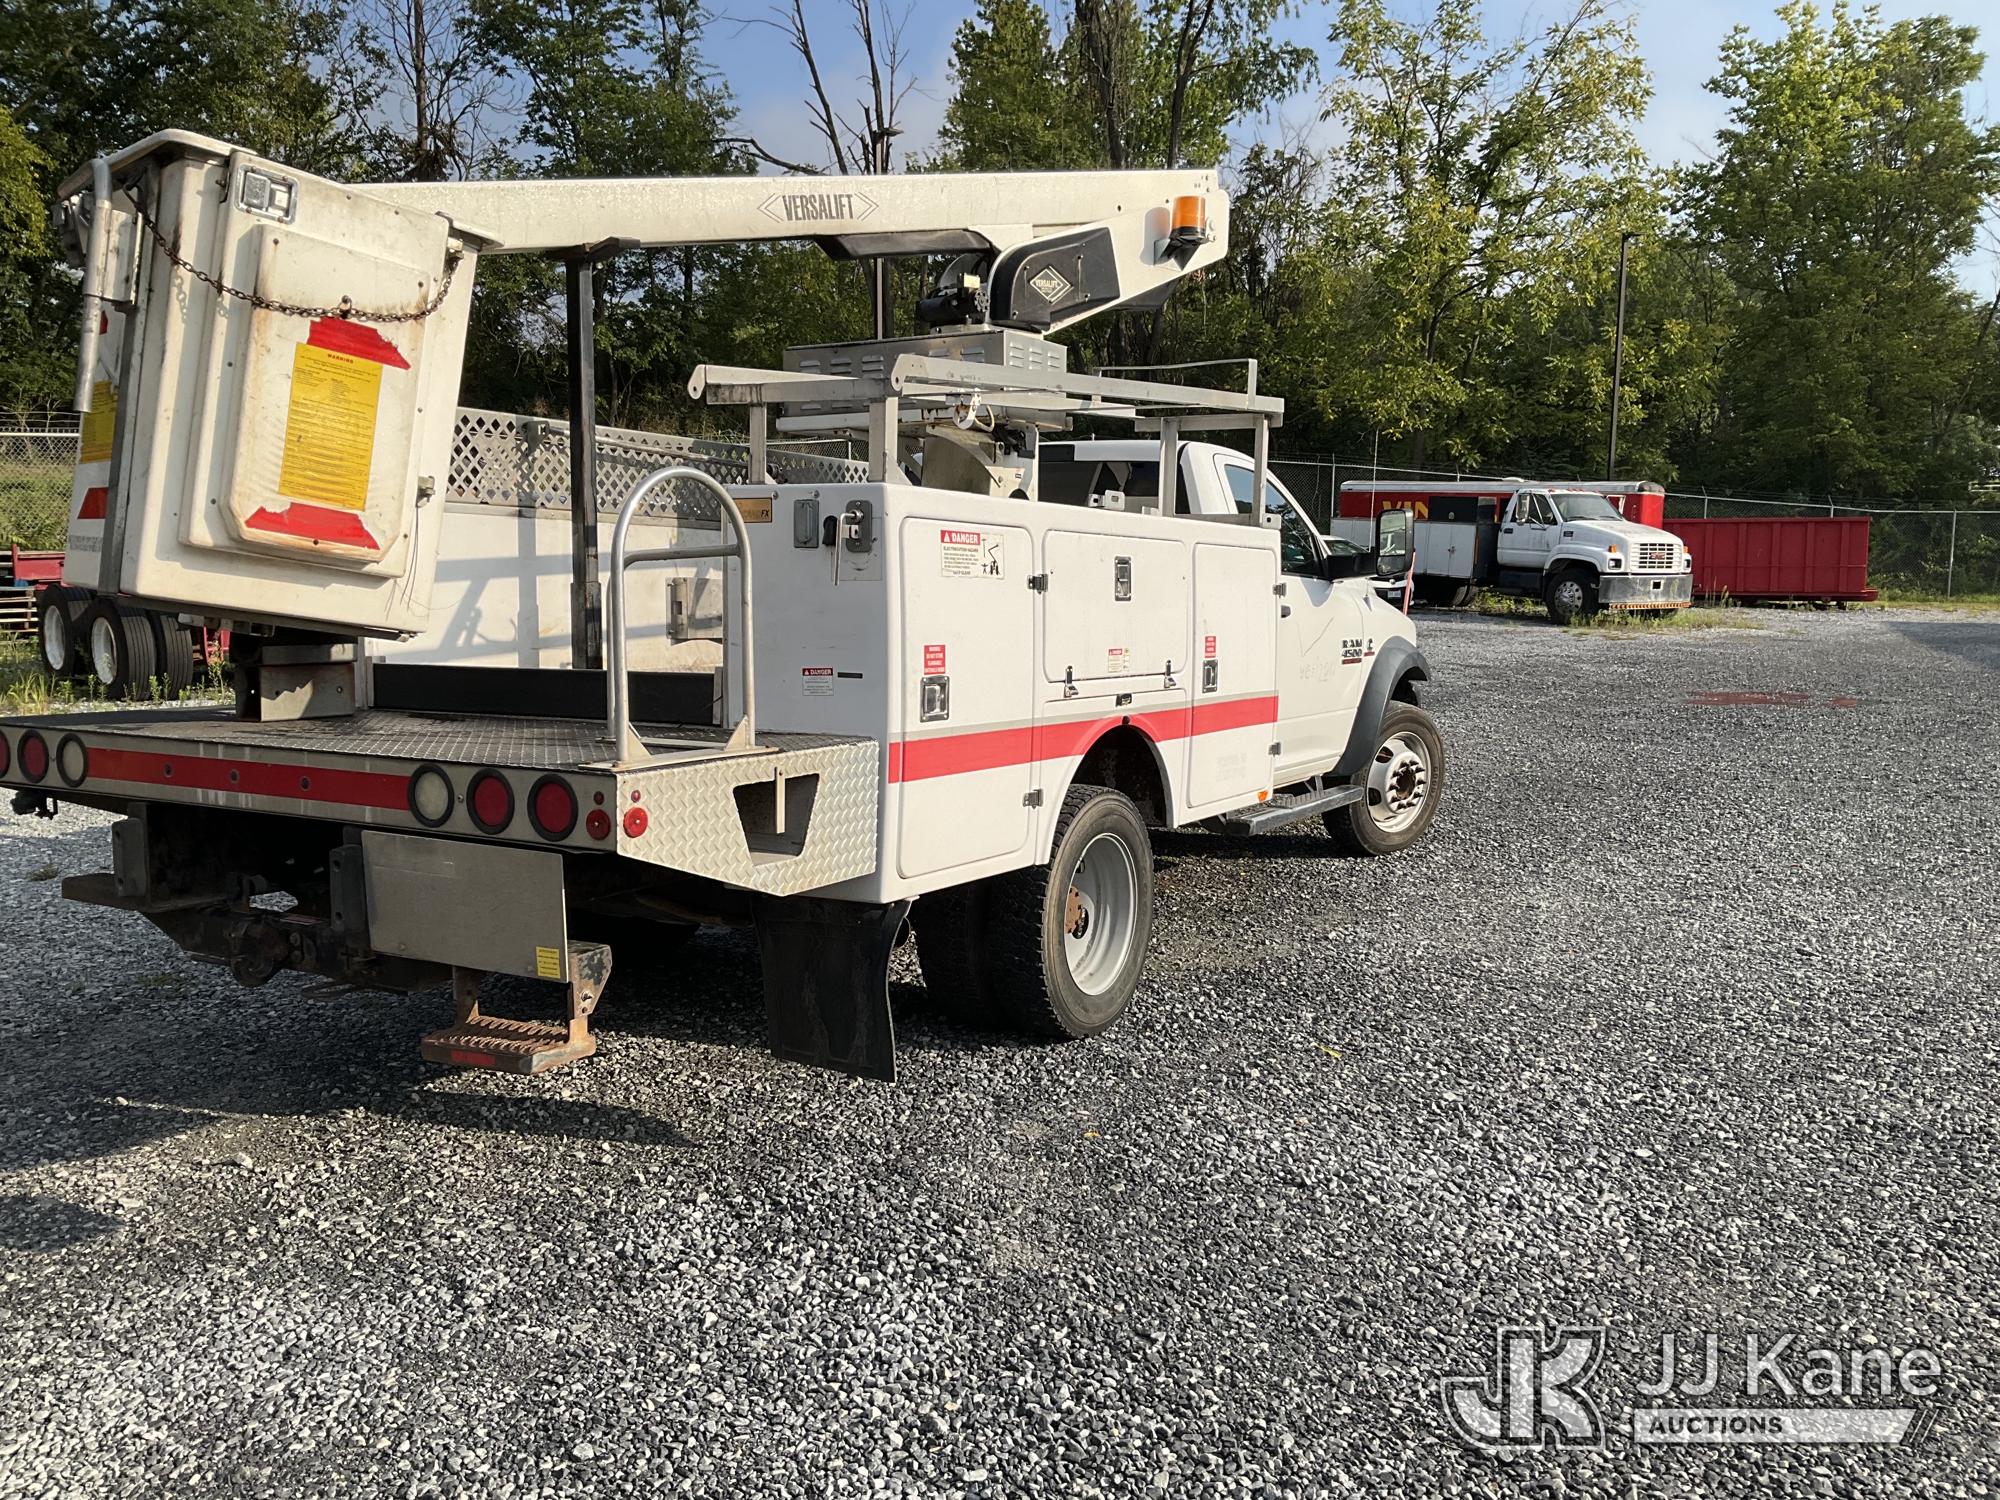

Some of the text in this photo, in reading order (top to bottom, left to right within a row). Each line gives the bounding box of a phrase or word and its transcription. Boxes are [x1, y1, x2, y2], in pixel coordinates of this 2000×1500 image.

[782, 194, 854, 221] VERSALIFT
[1035, 279, 1057, 288] VERSALIFT
[327, 353, 353, 363] WARNING
[951, 533, 978, 544] DANGER
[1342, 639, 1362, 648] RAM
[1342, 649, 1362, 657] 4500
